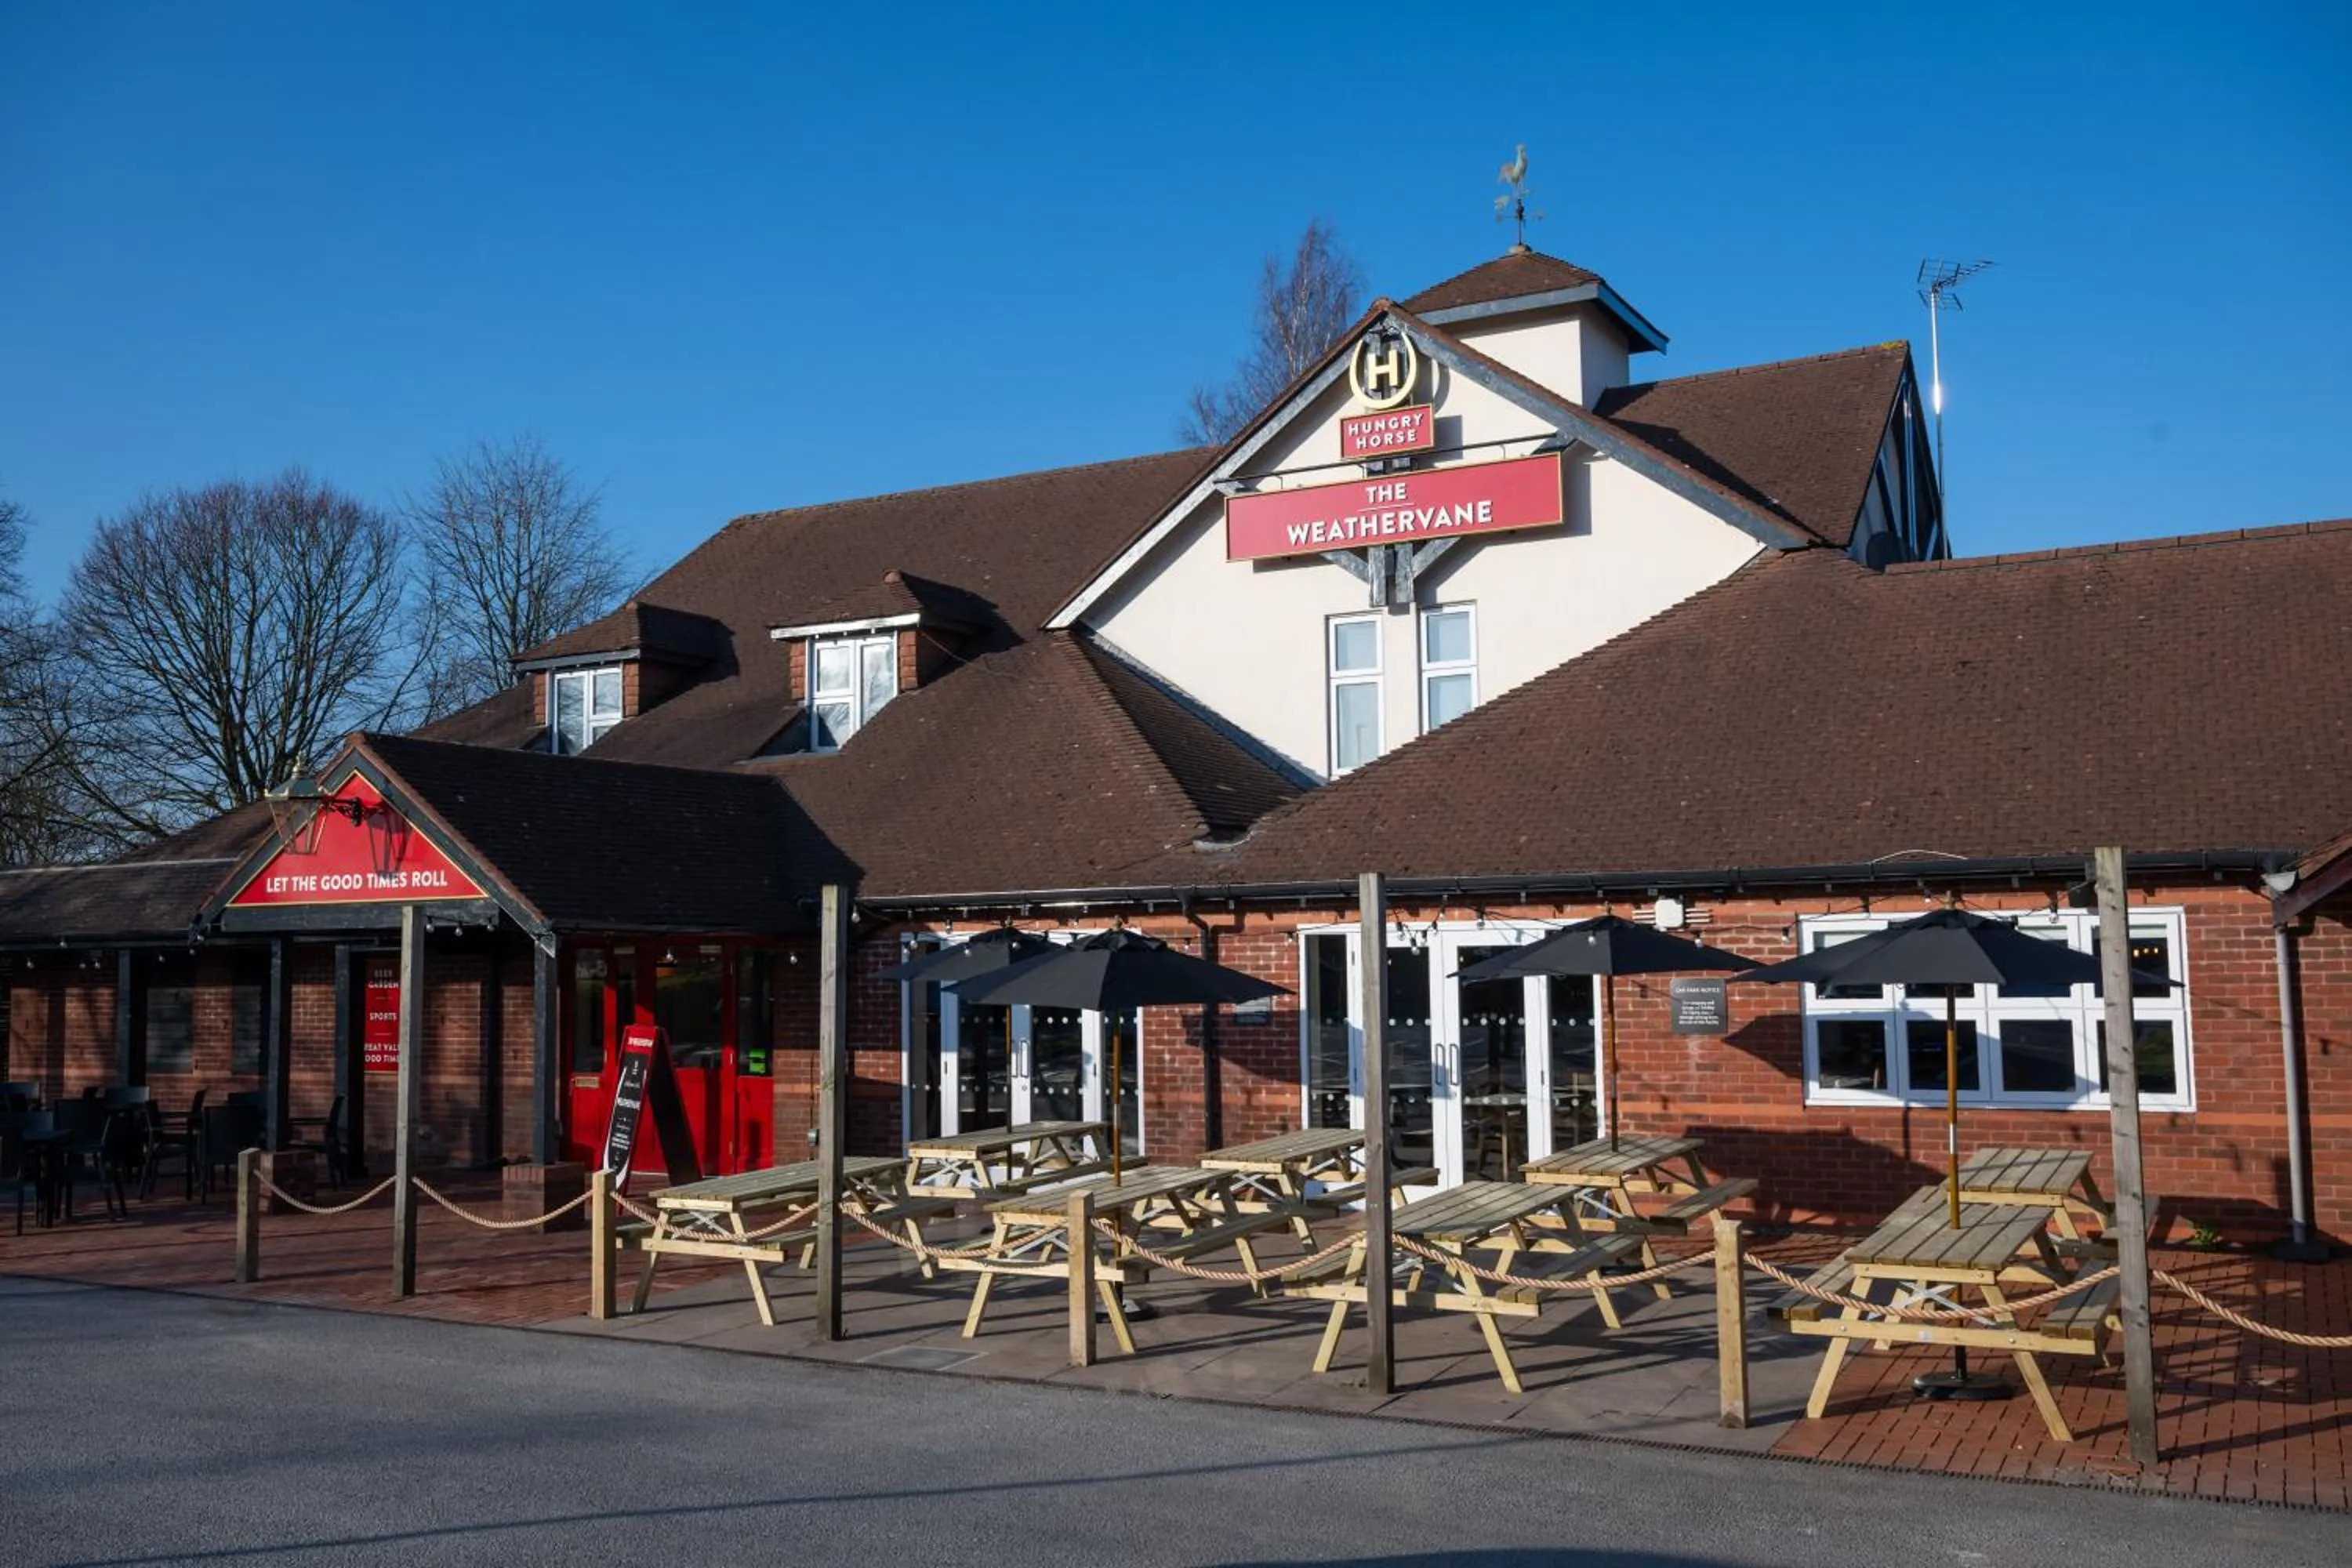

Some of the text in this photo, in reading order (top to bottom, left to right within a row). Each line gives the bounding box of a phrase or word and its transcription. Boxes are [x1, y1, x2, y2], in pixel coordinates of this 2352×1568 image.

[1368, 349, 1399, 390] H
[1348, 413, 1423, 436] HUNGRY
[1356, 429, 1417, 450] HORSE
[1365, 482, 1406, 503] THE
[1287, 499, 1493, 546] WEATHERVANE
[267, 870, 448, 893] LET THE GOOD TIMES ROLL
[369, 1012, 397, 1021] SPORTS
[364, 1043, 398, 1051] REAT VAL
[365, 1054, 382, 1063] OOD
